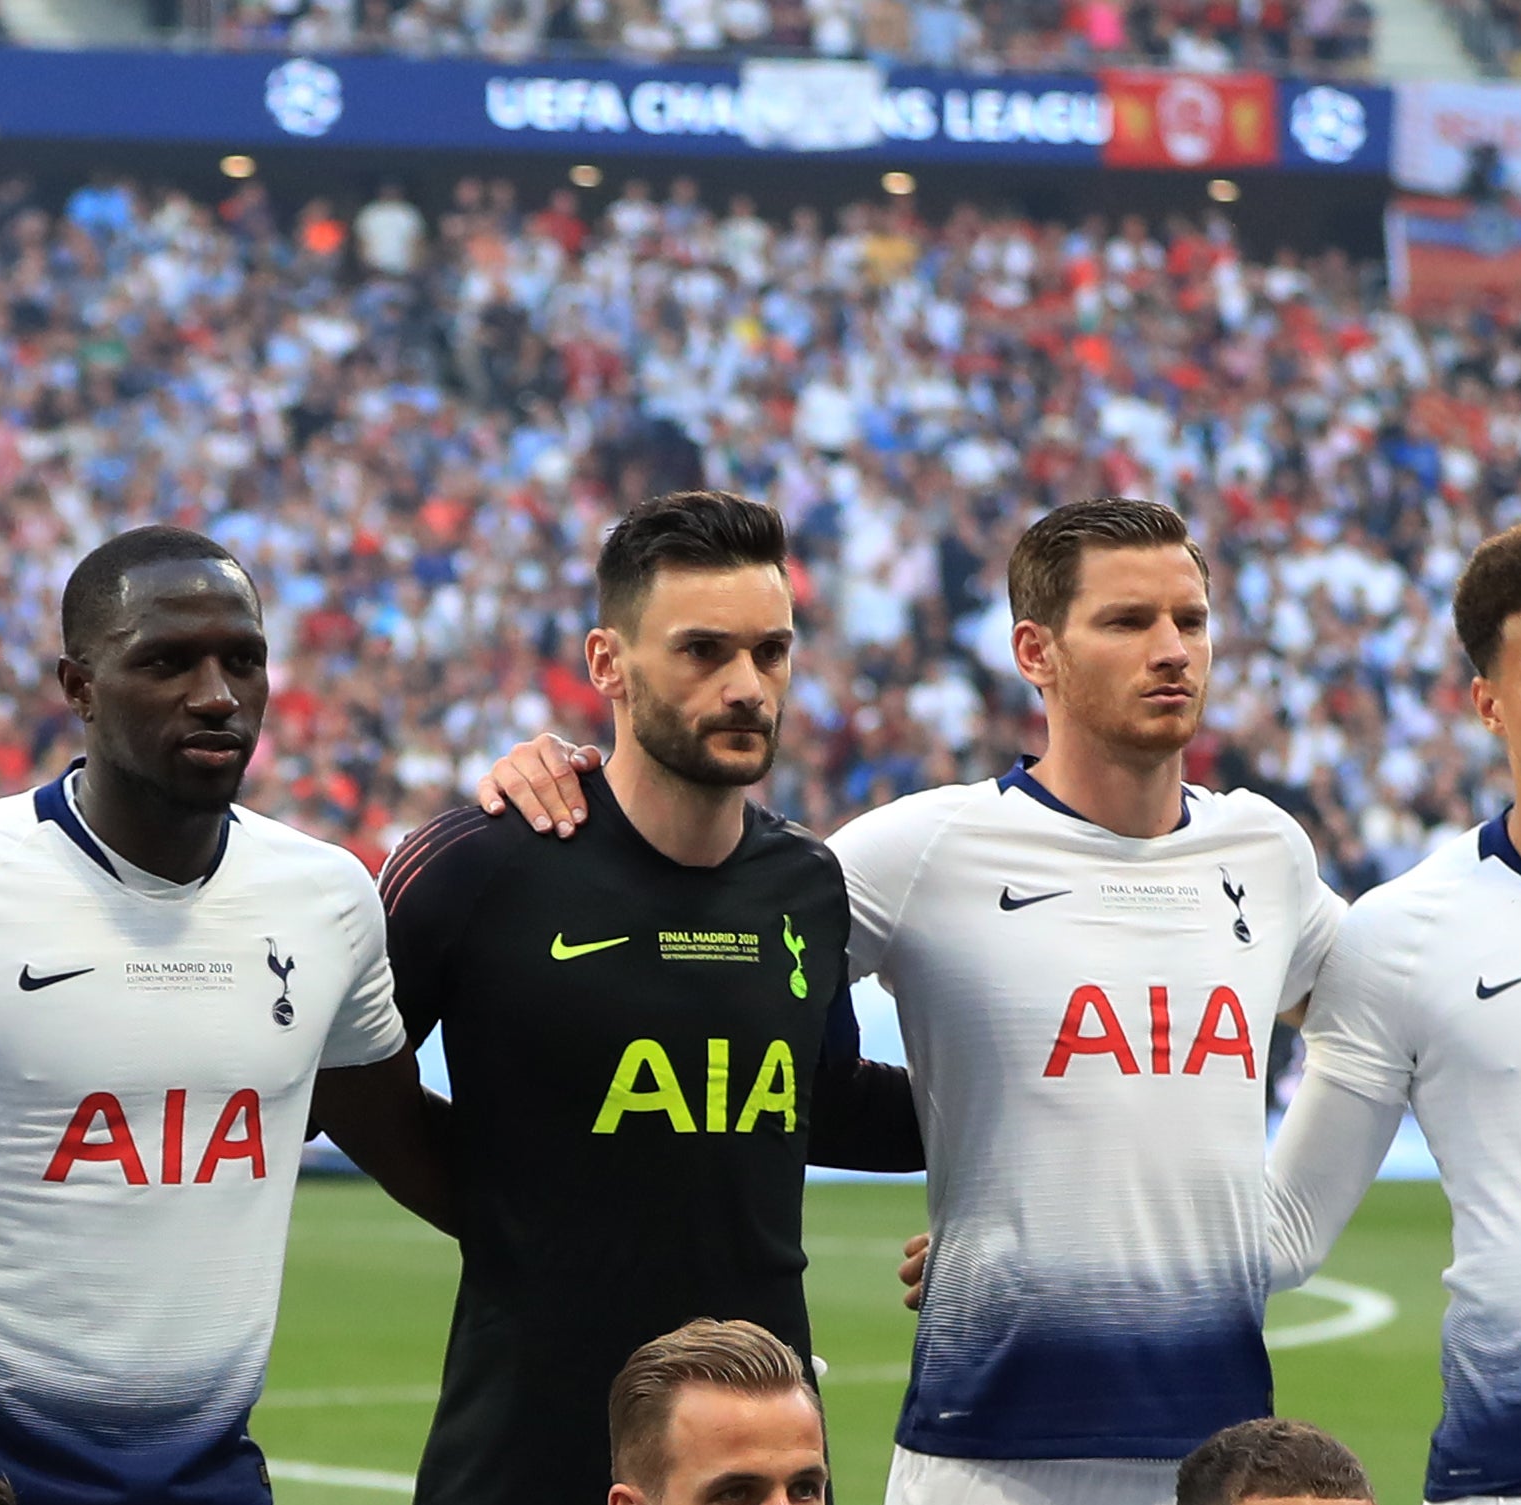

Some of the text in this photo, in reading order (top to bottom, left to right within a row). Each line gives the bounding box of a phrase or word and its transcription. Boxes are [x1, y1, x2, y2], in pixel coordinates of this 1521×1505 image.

[485, 76, 629, 133] UEFA
[1100, 885, 1131, 895] FINAL
[1133, 885, 1175, 896] MADRID
[658, 932, 759, 945] FINAL MADRID 2019
[126, 963, 233, 973] FINAL MADRID 2019
[1042, 984, 1257, 1080] AIA
[591, 1038, 798, 1135] AIA
[42, 1088, 267, 1186] AIA
